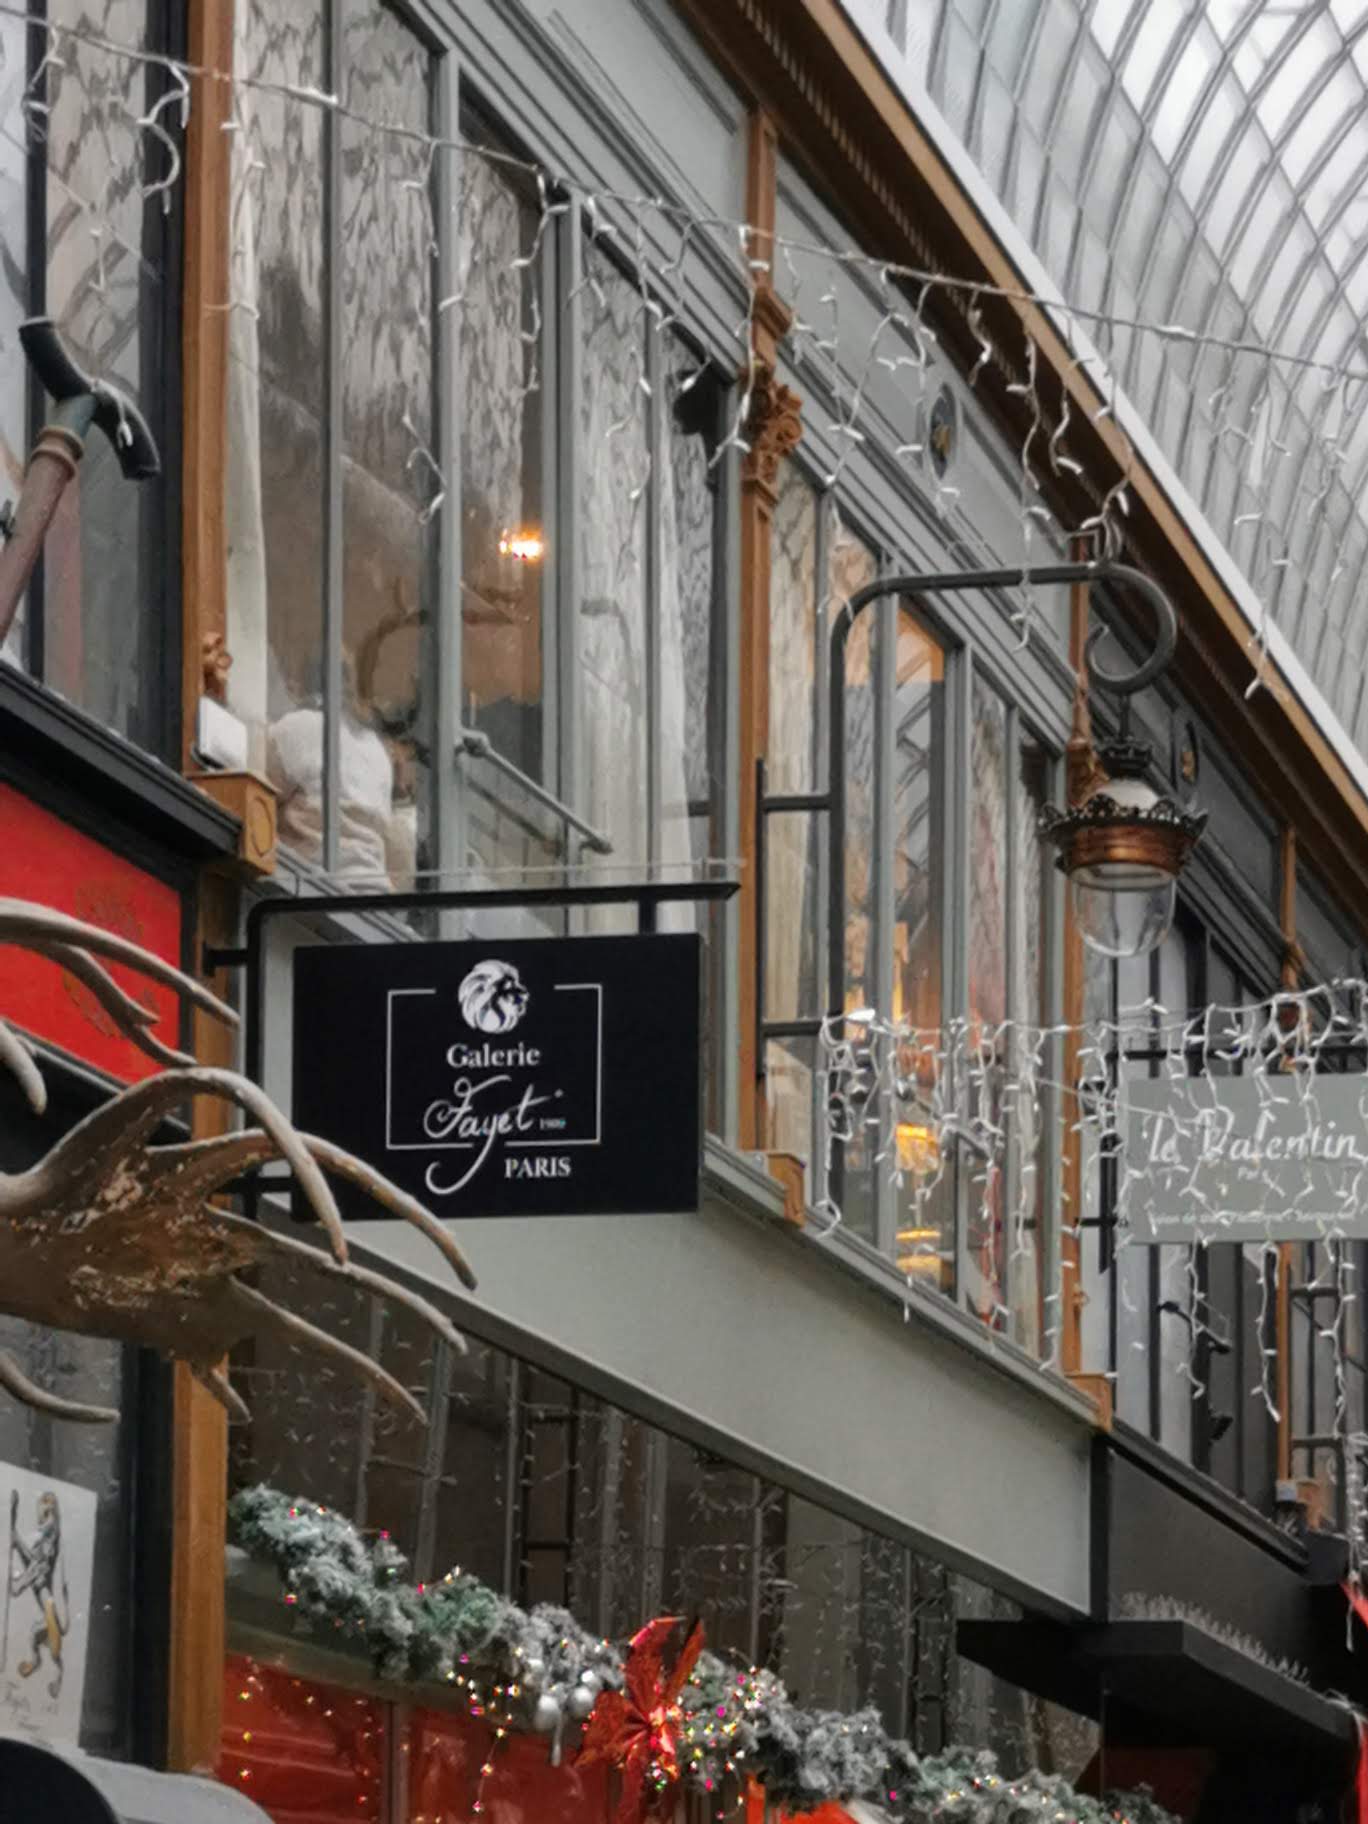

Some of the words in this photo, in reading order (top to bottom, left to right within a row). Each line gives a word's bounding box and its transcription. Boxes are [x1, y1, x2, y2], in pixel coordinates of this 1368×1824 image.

[446, 1042, 541, 1068] Galerie
[424, 1074, 555, 1194] Fayet
[505, 1157, 571, 1179] PARIS
